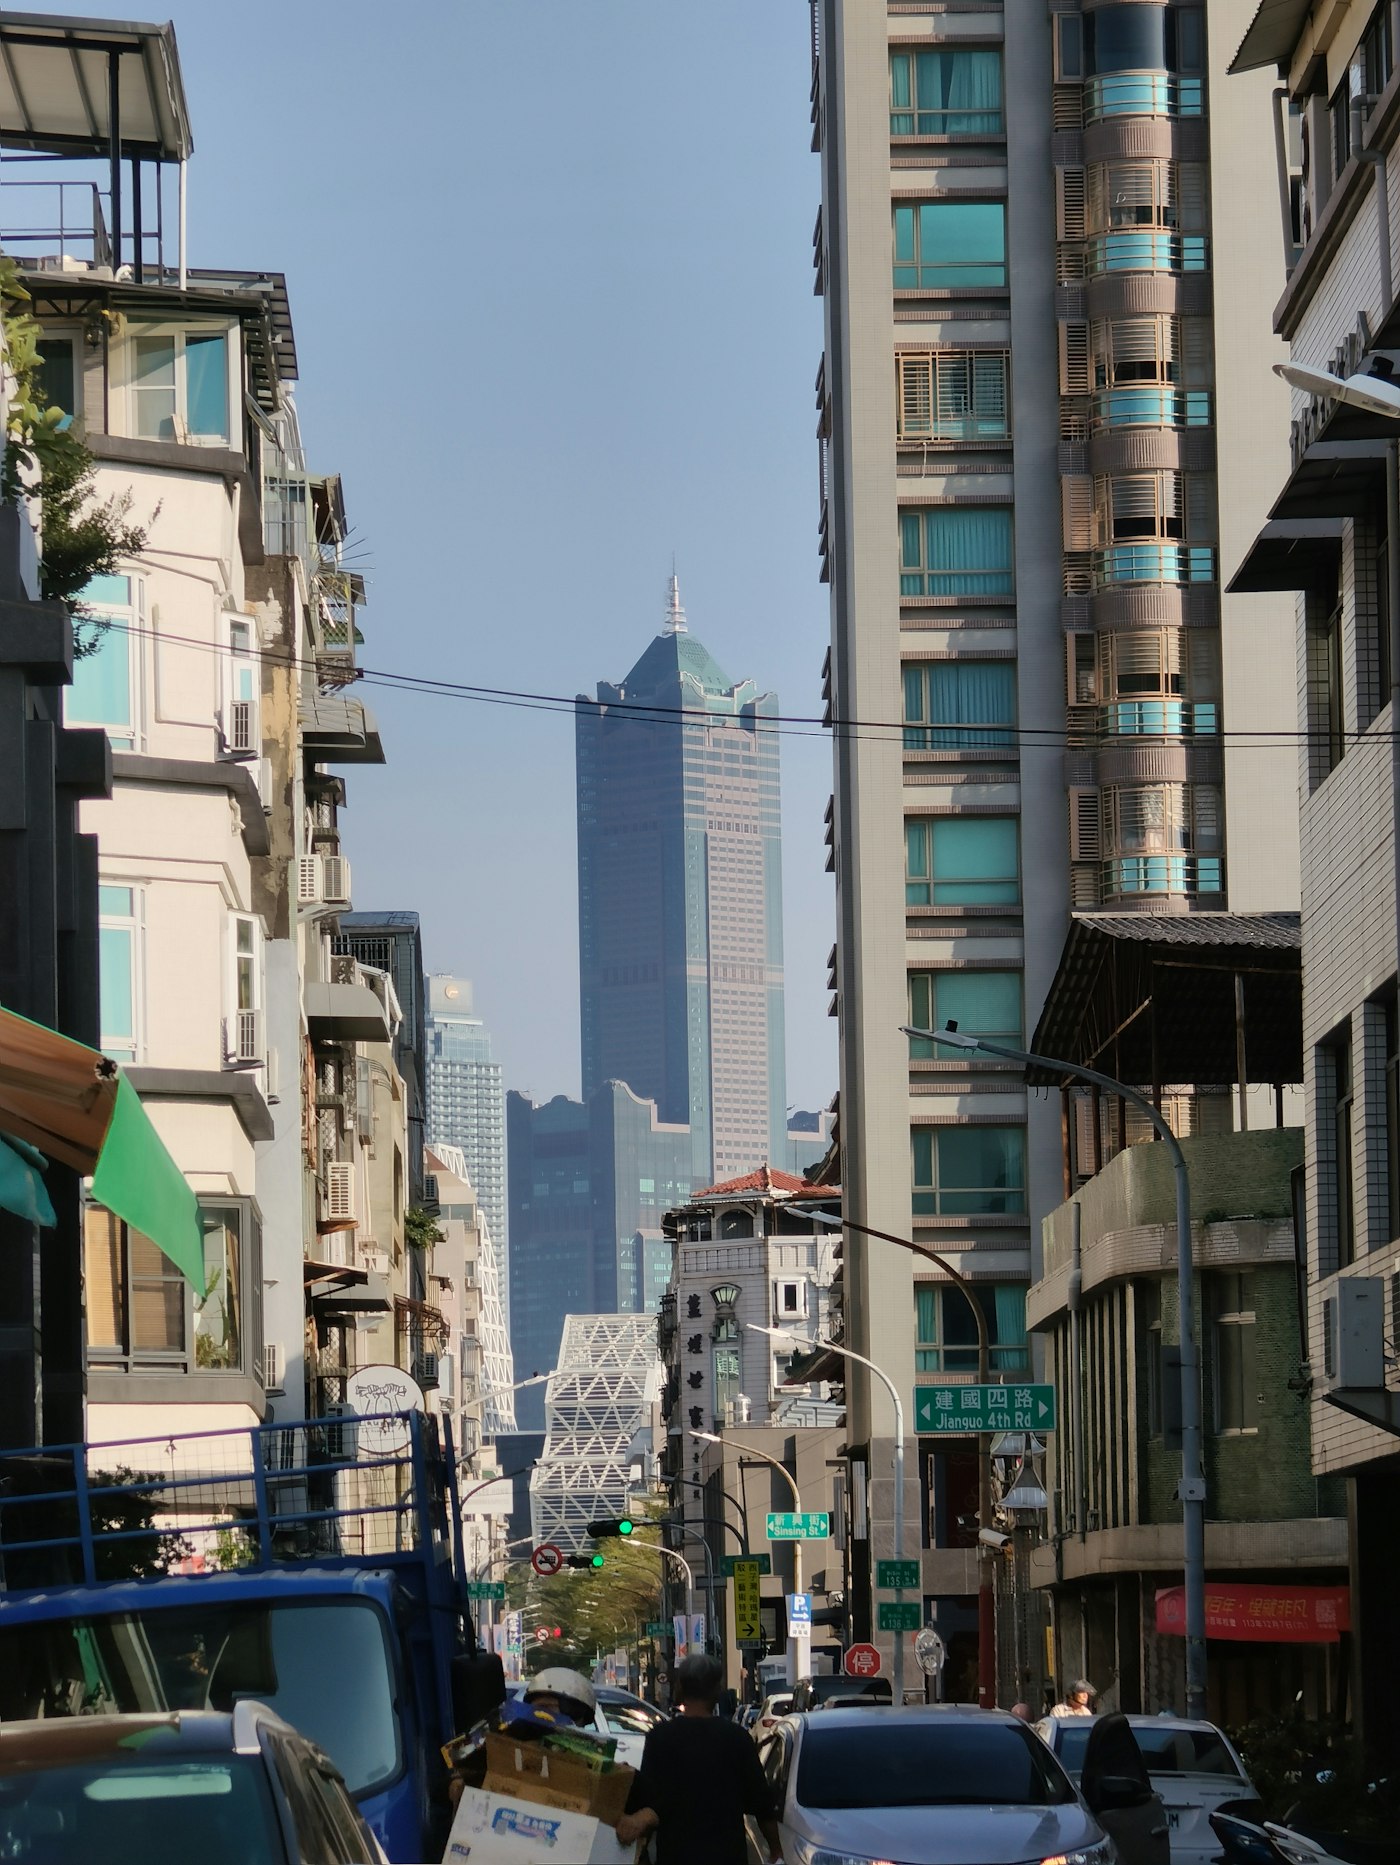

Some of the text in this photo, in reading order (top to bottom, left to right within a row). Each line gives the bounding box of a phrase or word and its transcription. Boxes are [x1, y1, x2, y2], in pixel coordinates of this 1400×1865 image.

[934, 1388, 1034, 1411] 建國四路
[935, 1412, 983, 1430] Jianguo
[987, 1412, 1011, 1429] 4th
[774, 1514, 820, 1527] 新興街
[773, 1526, 807, 1538] Sinsing
[886, 1576, 901, 1586] 135
[794, 1596, 806, 1611] P
[851, 1650, 874, 1673] 停
